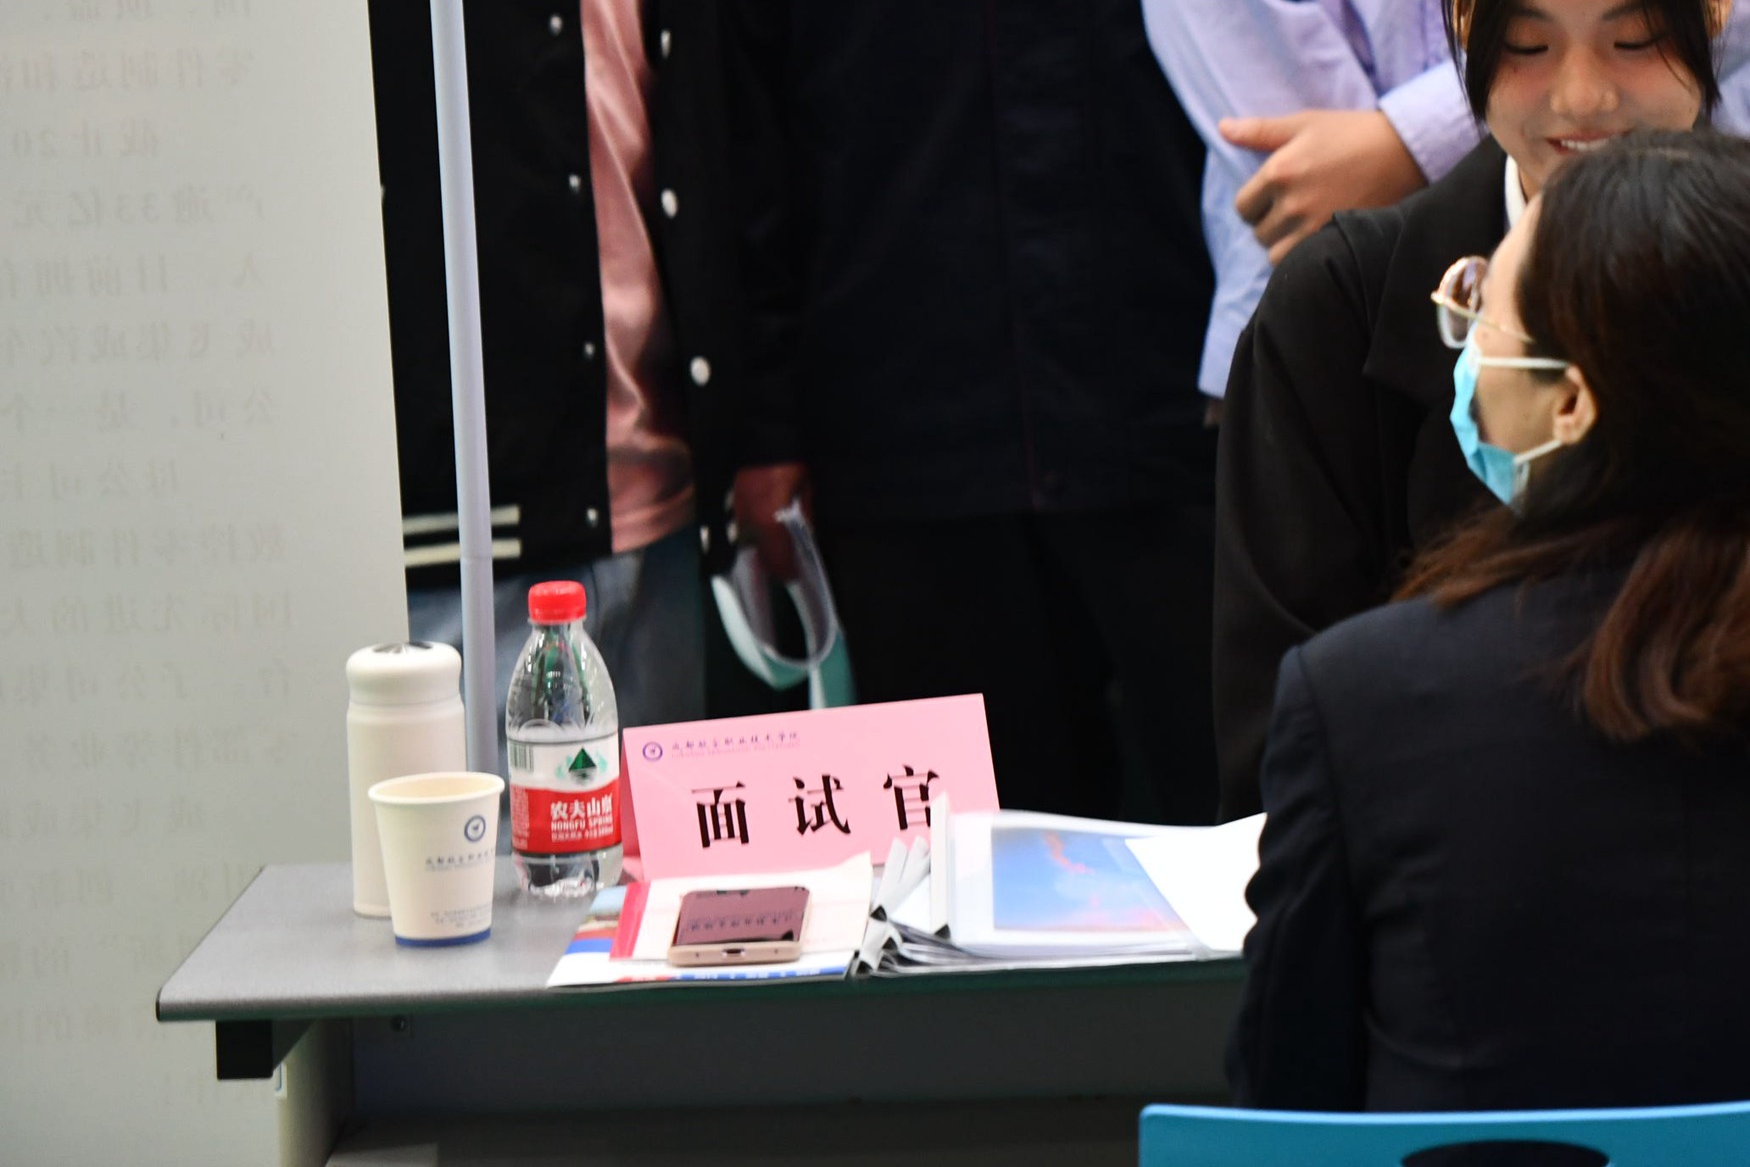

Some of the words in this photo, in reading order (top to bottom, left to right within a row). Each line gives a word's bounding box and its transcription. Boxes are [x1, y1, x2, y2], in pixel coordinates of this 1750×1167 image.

[551, 794, 612, 820] 农夫山泉
[691, 765, 940, 849] 面试官
